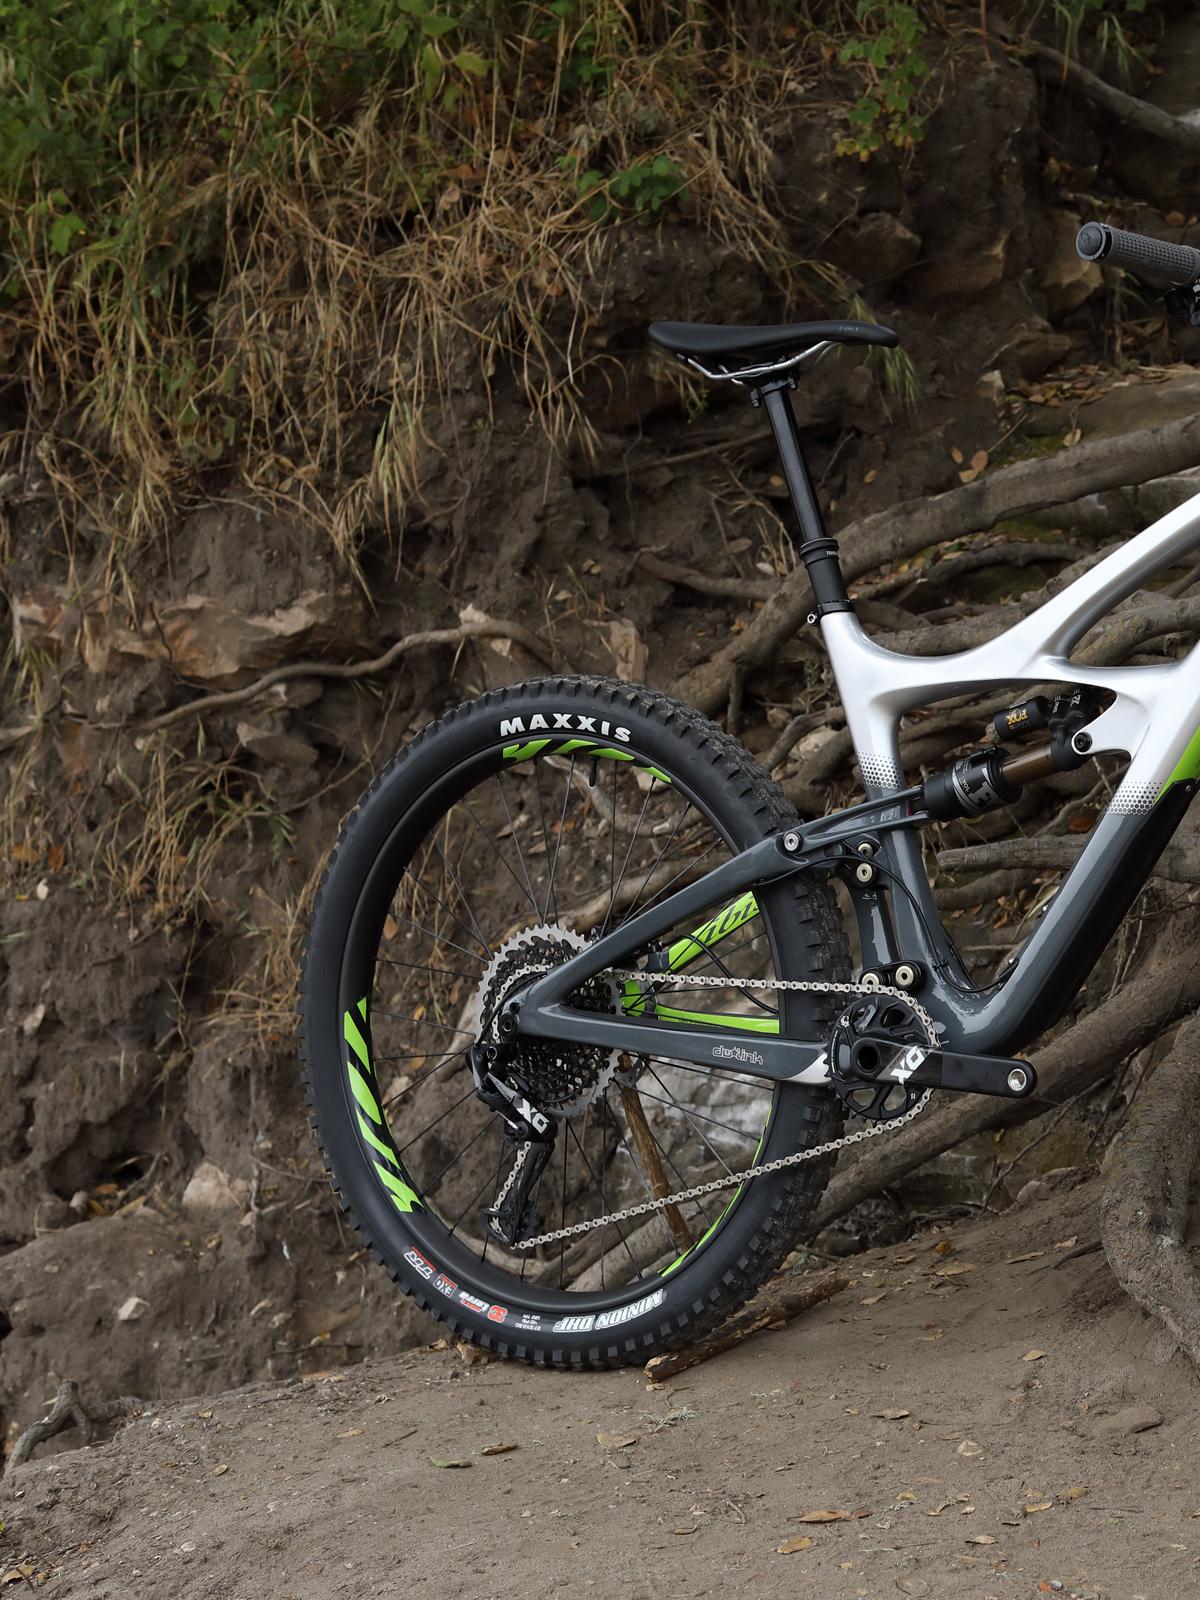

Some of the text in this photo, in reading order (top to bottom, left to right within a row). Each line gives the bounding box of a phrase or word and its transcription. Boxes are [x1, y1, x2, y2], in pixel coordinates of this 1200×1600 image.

[500, 713, 631, 742] MAXXIS
[403, 1250, 434, 1280] TR
[552, 1288, 664, 1333] MINION DHF
